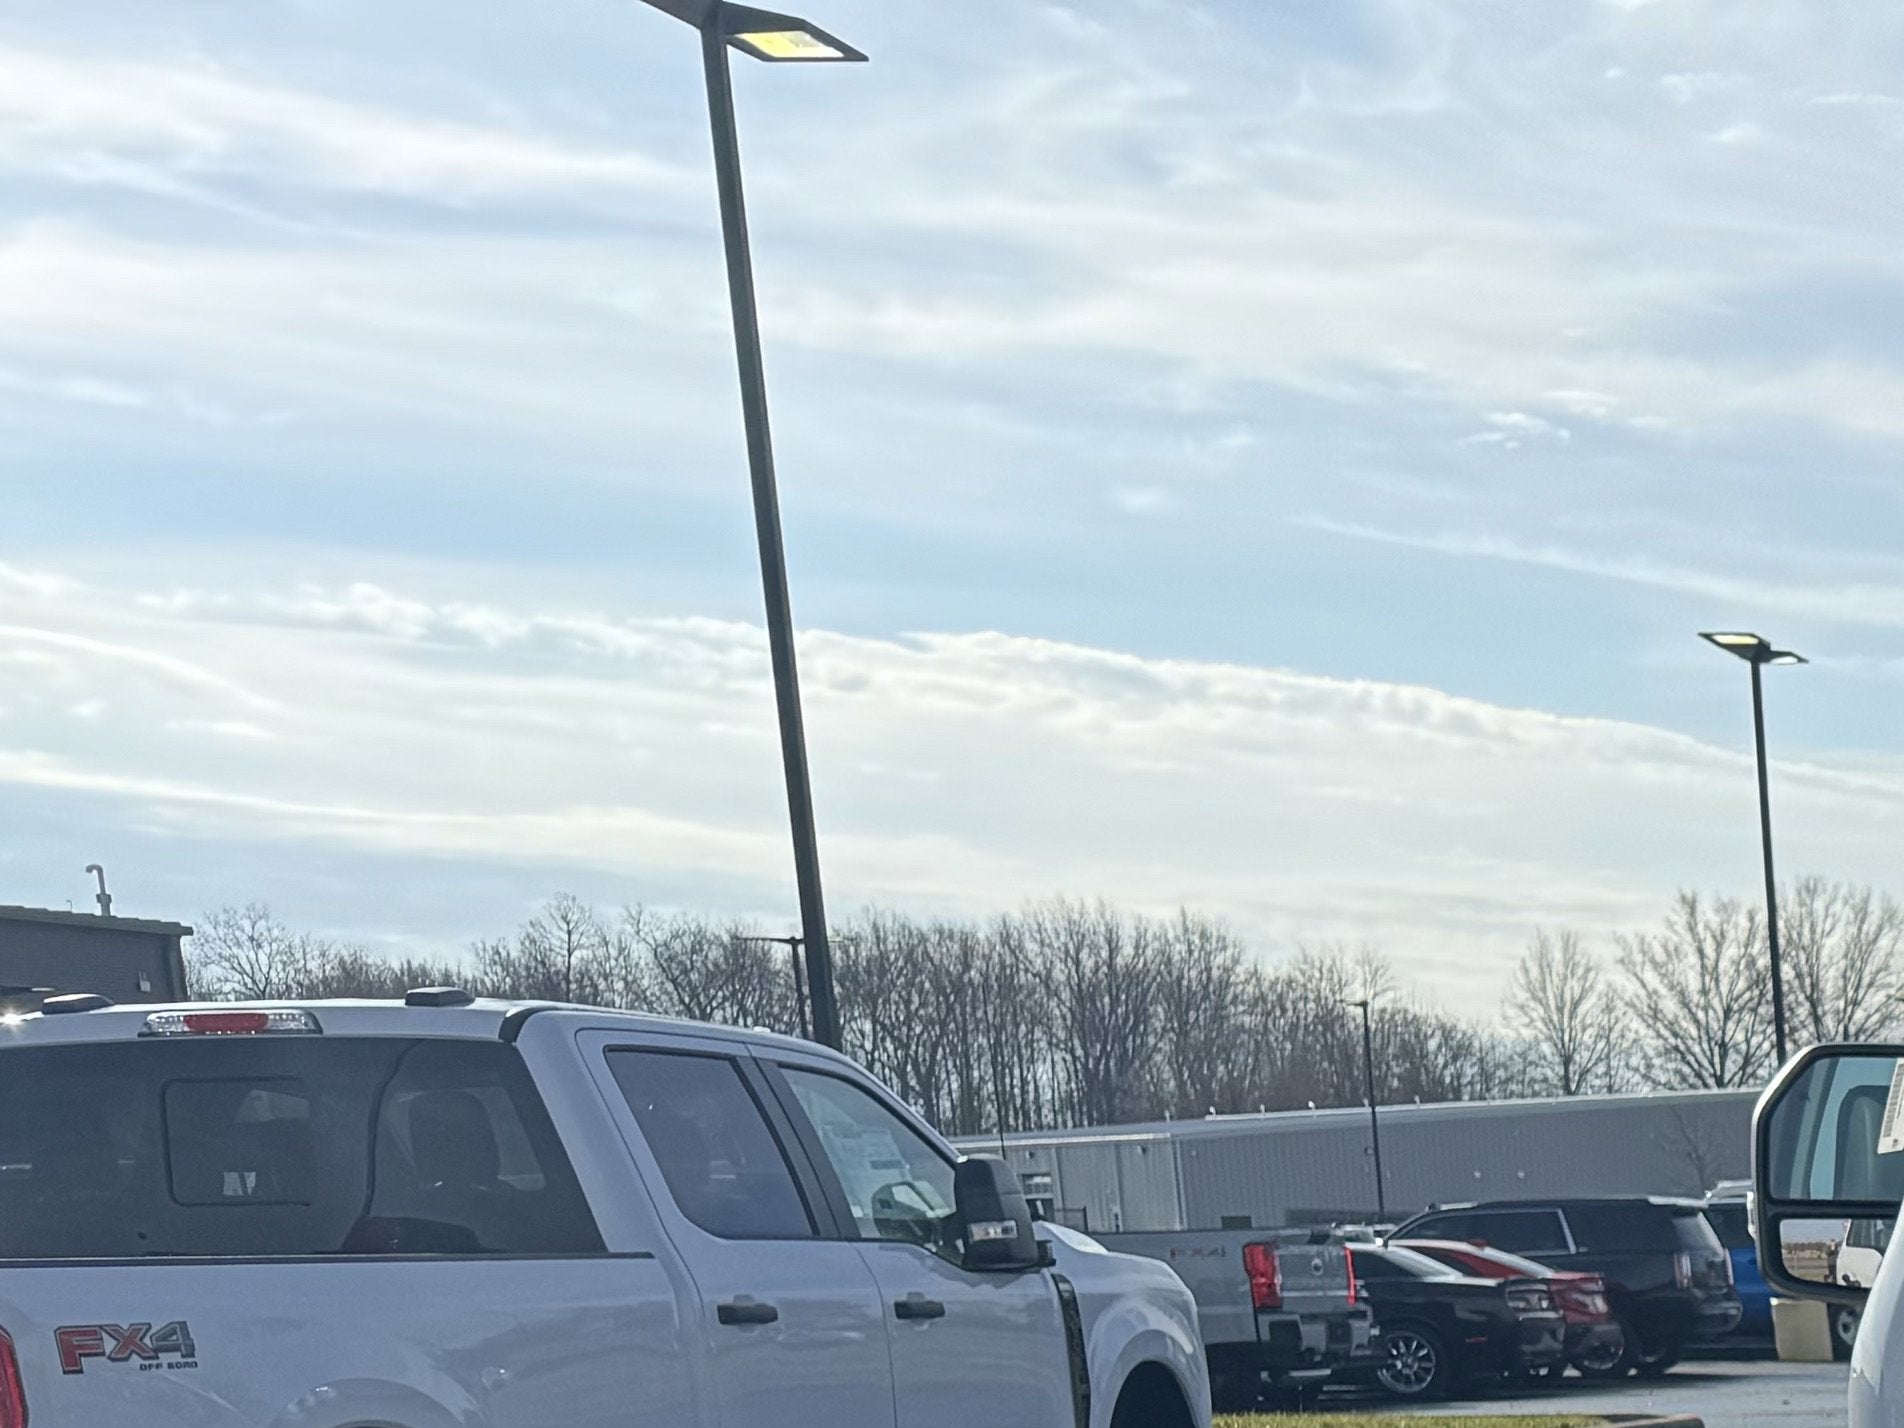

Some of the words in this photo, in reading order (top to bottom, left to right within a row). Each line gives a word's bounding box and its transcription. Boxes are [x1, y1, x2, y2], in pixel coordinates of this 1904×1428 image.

[54, 1321, 195, 1374] FX4
[139, 1361, 163, 1371] OFF
[167, 1360, 198, 1370] ROAD
